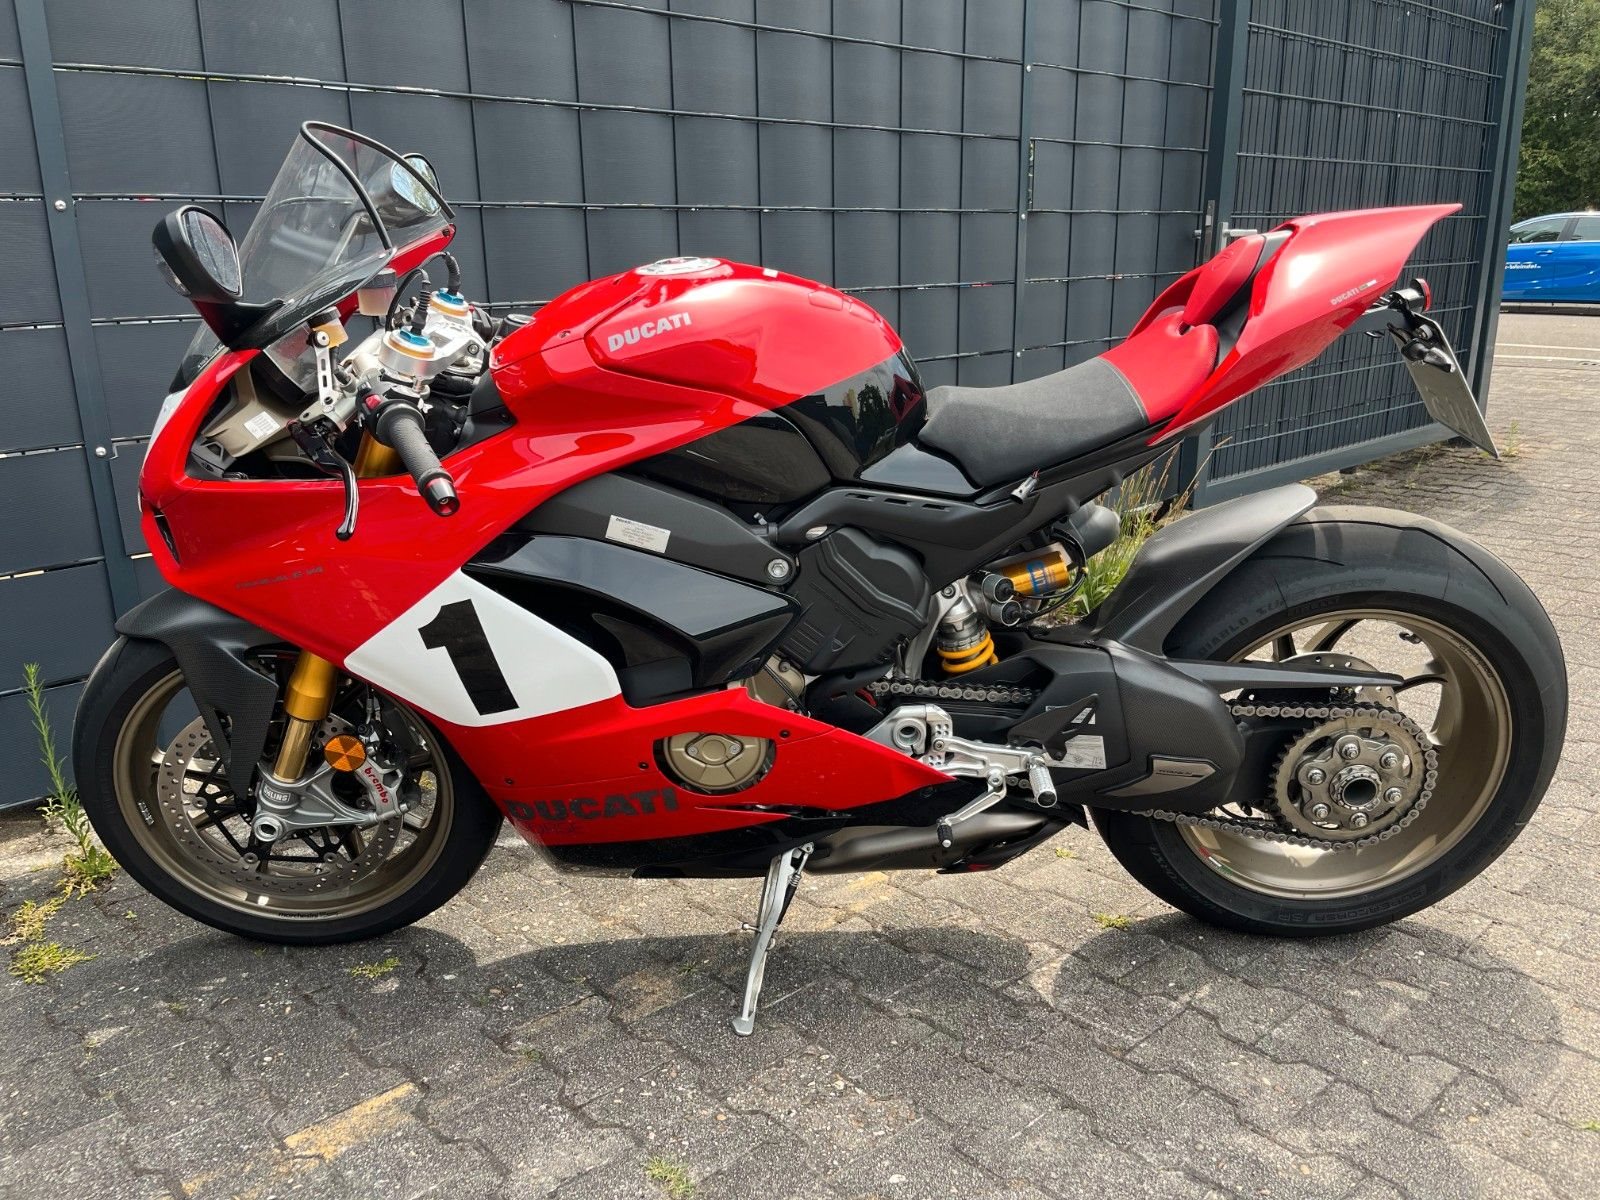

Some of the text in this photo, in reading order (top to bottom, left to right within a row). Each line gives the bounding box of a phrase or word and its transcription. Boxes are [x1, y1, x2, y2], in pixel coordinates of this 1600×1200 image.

[1331, 287, 1359, 305] DUCATI
[607, 312, 693, 352] DUCATI
[418, 598, 520, 716] 1
[364, 767, 389, 804] brembo
[503, 787, 680, 822] DUCATI
